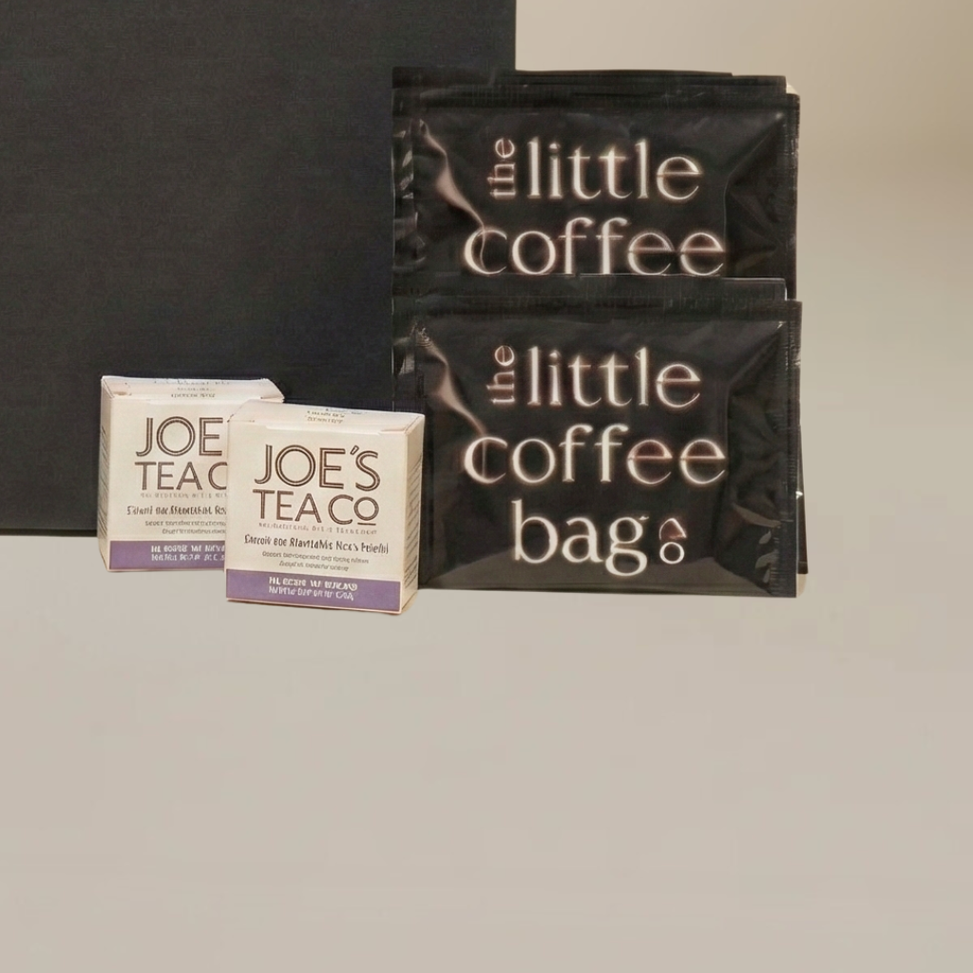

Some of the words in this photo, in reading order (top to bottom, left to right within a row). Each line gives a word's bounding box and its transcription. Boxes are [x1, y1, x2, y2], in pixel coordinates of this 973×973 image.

[487, 137, 515, 200] the
[527, 136, 702, 201] little
[463, 217, 726, 276] coffee
[487, 344, 515, 406] the
[527, 345, 702, 408] little
[254, 444, 380, 491] JOE'S
[463, 423, 726, 485] coffee
[511, 499, 649, 577] bag
